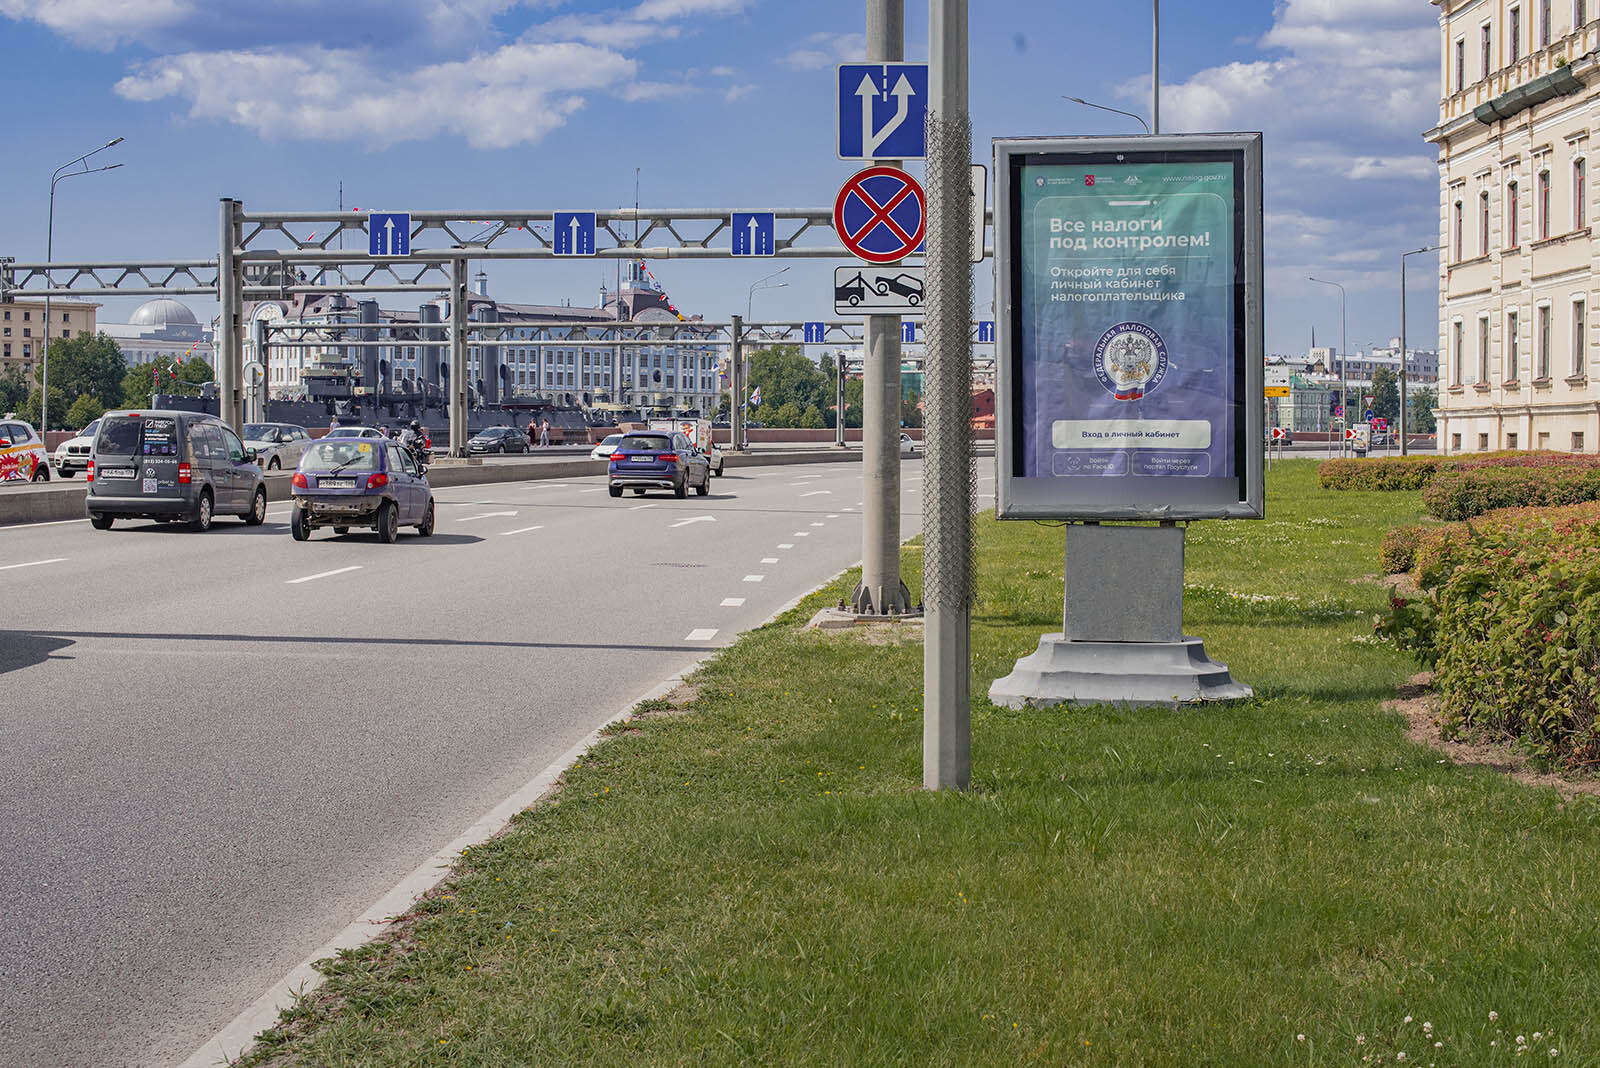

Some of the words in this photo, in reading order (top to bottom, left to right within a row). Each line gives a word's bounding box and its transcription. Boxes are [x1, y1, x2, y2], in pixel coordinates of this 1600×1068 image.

[1049, 218, 1086, 233] Все
[1091, 218, 1163, 232] налоги
[1049, 235, 1087, 251] под
[1093, 232, 1210, 250] контролем!
[1050, 265, 1114, 278] Откройте
[1116, 266, 1142, 278] для
[1145, 264, 1176, 277] себя
[1051, 278, 1102, 289] личный
[1105, 277, 1160, 289] кабинет
[1051, 291, 1185, 303] налогоплательщика
[1095, 330, 1116, 383] ФЕДЕРАЛЬНАЯ
[1119, 324, 1162, 348] НАЛОГОВАЯ
[1152, 351, 1166, 384] СЛУЖБА
[1081, 430, 1102, 439] Вход
[1111, 430, 1143, 439] личный
[1145, 430, 1180, 439] кабинет
